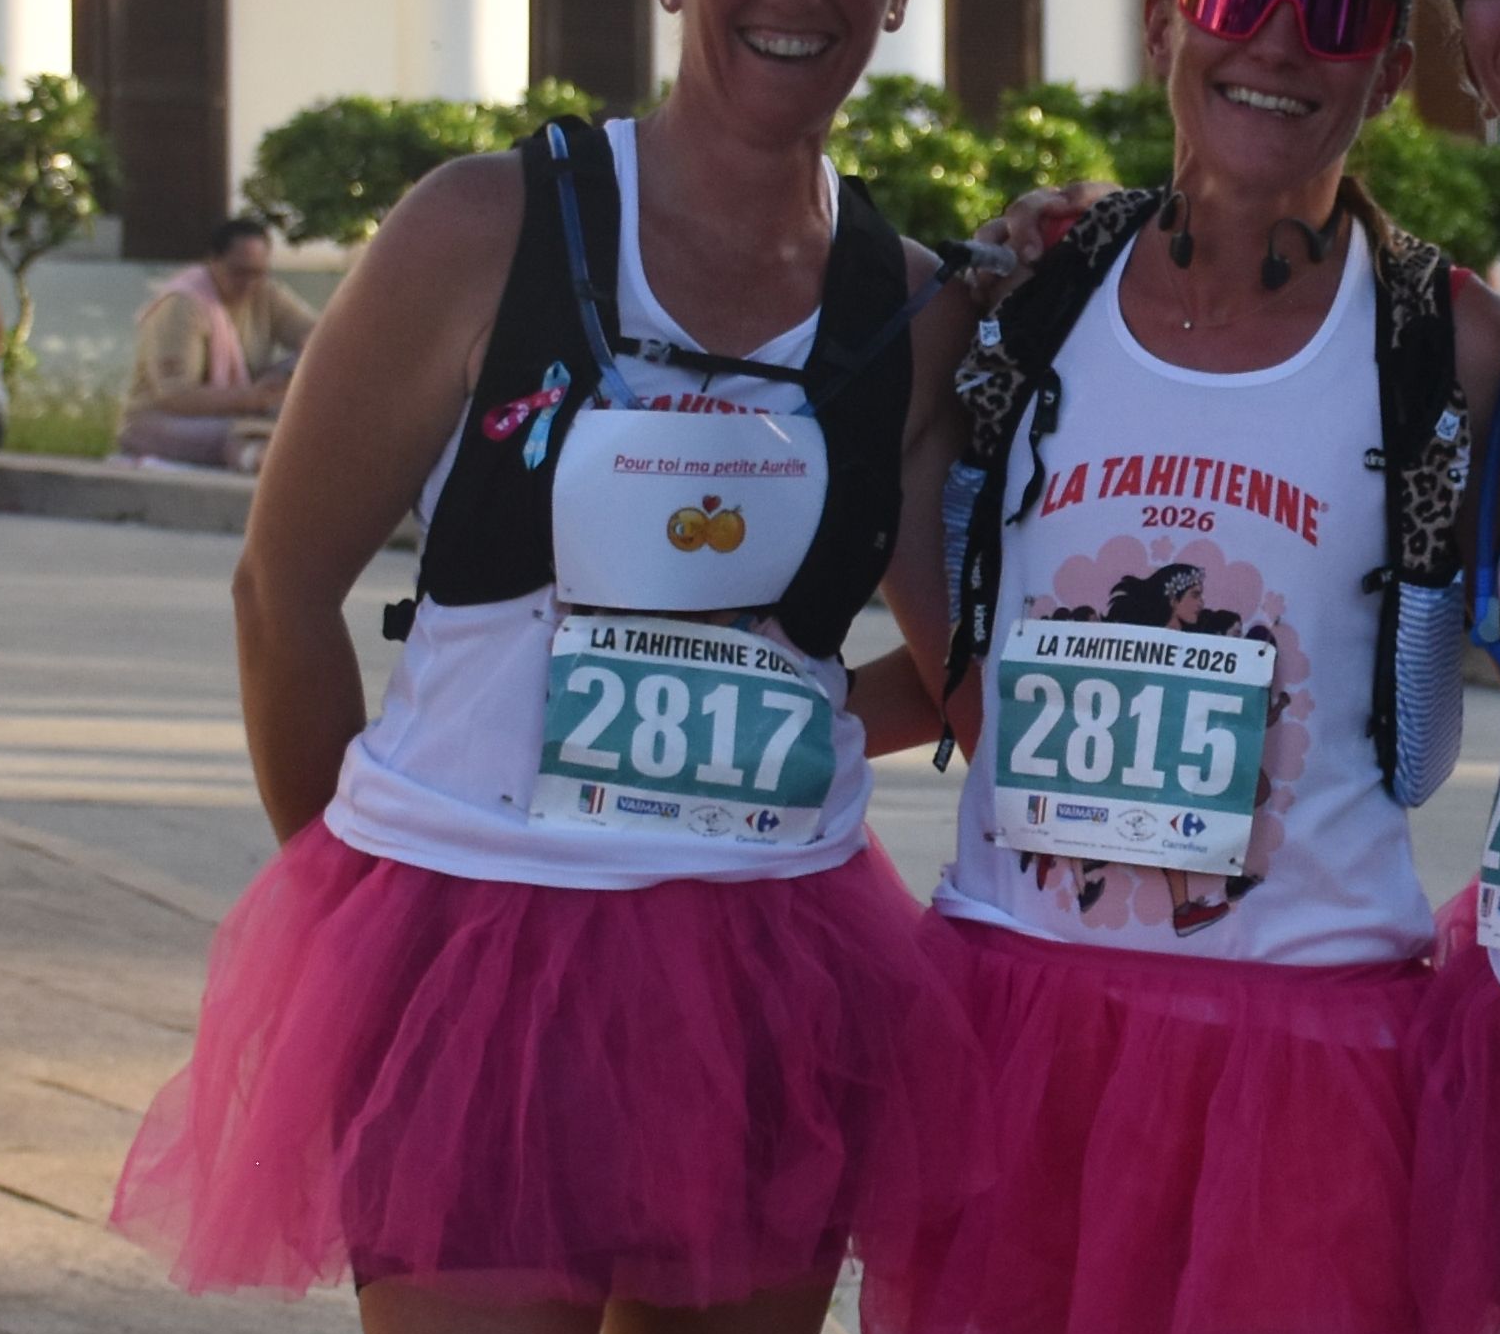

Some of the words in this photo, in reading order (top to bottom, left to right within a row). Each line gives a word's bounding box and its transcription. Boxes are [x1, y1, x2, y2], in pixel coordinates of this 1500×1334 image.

[614, 454, 652, 471] Pour
[658, 457, 681, 472] toi
[685, 461, 710, 473] ma
[714, 460, 757, 476] petite
[760, 458, 807, 475] Aurélie
[1040, 463, 1089, 517] LA
[1098, 454, 1319, 547] TAHITIENNE
[1141, 506, 1215, 532] 2026
[590, 627, 616, 650] LA
[624, 629, 748, 667] TAHITIENNE
[755, 648, 806, 678] 202
[1036, 635, 1059, 657] LA
[1064, 636, 1179, 667] TAHITIENNE
[1182, 647, 1238, 675] 2026
[559, 665, 813, 792] 2817
[1010, 672, 1244, 797] 2815
[619, 797, 680, 817] VAIMATO
[1057, 804, 1109, 822] VAIMATO
